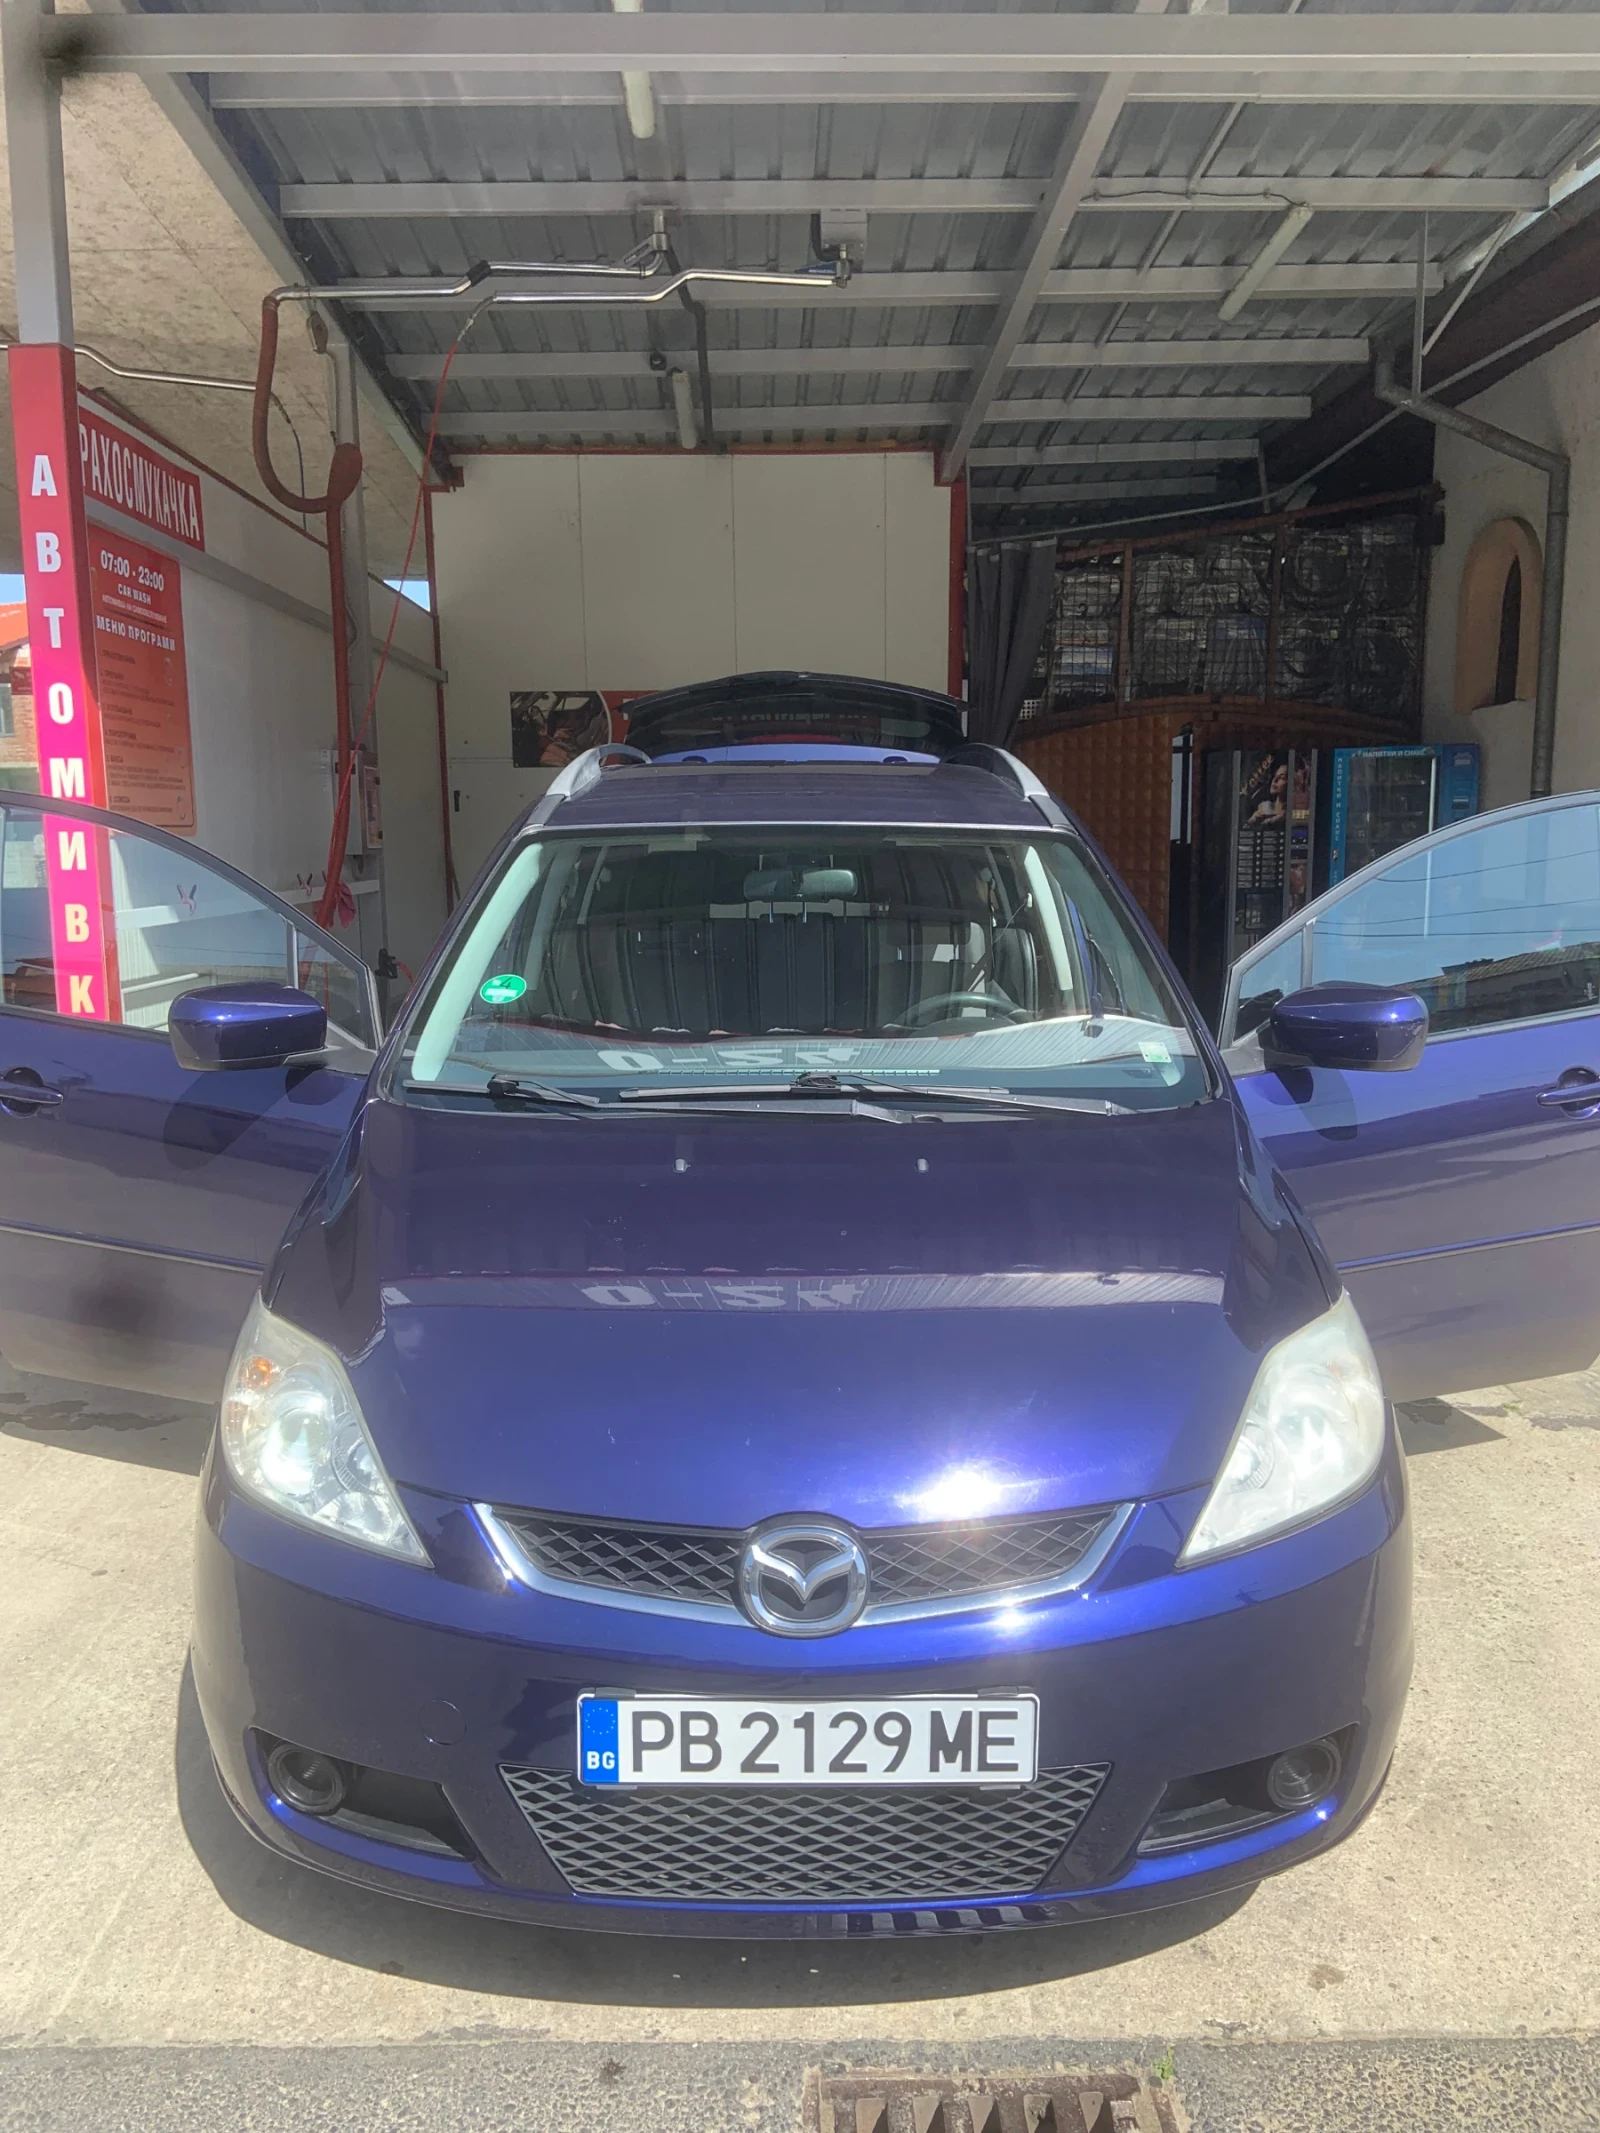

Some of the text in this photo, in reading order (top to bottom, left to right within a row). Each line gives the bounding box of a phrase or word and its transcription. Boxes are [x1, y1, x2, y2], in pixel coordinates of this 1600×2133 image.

[100, 549, 130, 578] 07:00
[138, 565, 164, 592] 23:00
[117, 583, 152, 605] CAR WASH
[96, 614, 176, 651] МЕНЮ ПРОГРАМИ
[499, 976, 513, 989] 4
[631, 1710, 1019, 1773] PB 2129 ME
[586, 1751, 616, 1770] BG
